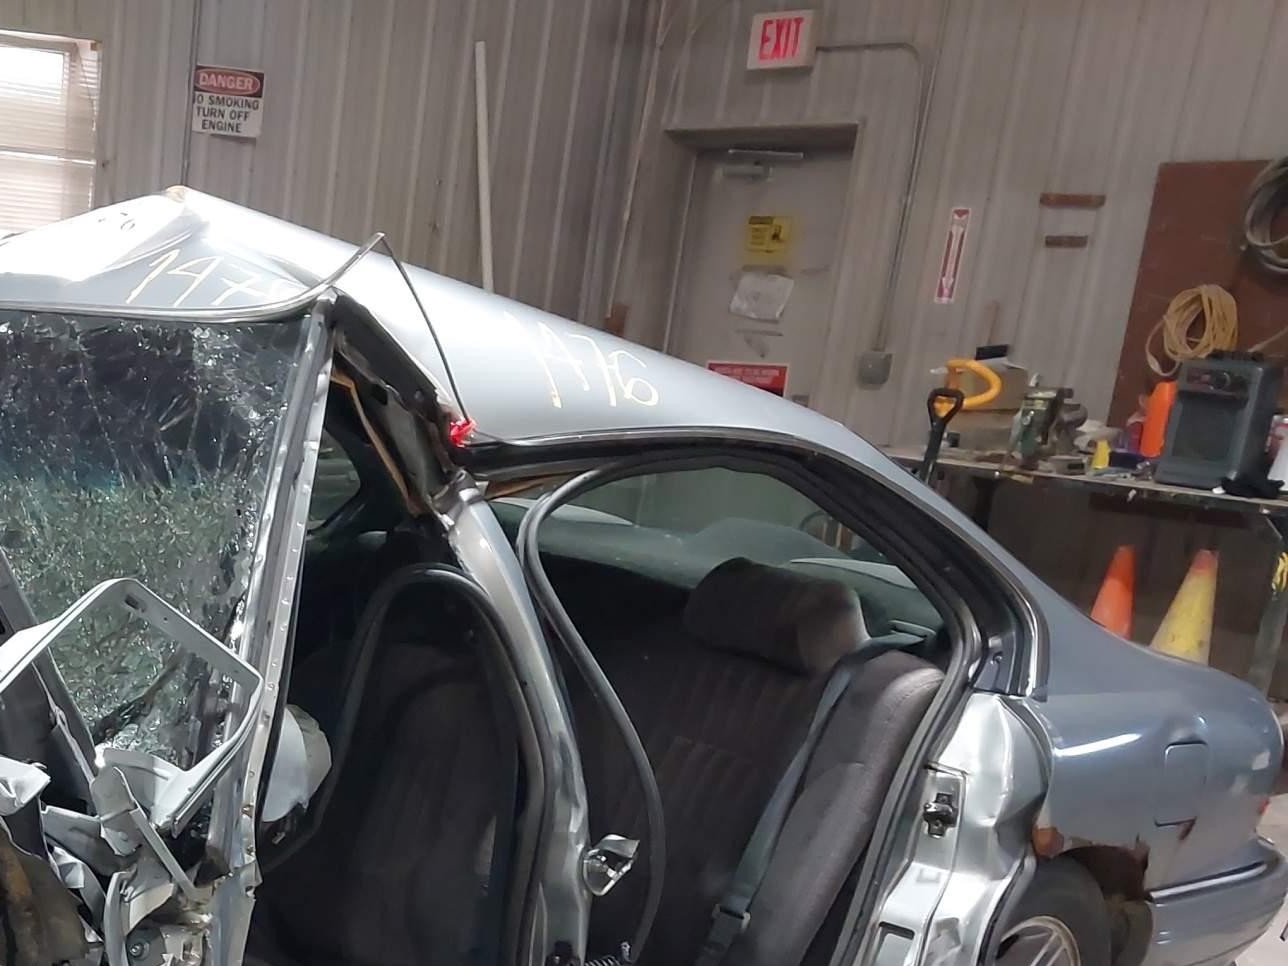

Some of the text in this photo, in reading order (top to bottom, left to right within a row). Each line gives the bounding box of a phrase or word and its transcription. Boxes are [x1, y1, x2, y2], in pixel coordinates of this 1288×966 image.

[758, 16, 804, 60] EXIT
[199, 72, 253, 90] DANGER
[208, 95, 260, 111] SMOKING
[196, 106, 249, 121] TURN OFF
[201, 119, 242, 133] ENGINE
